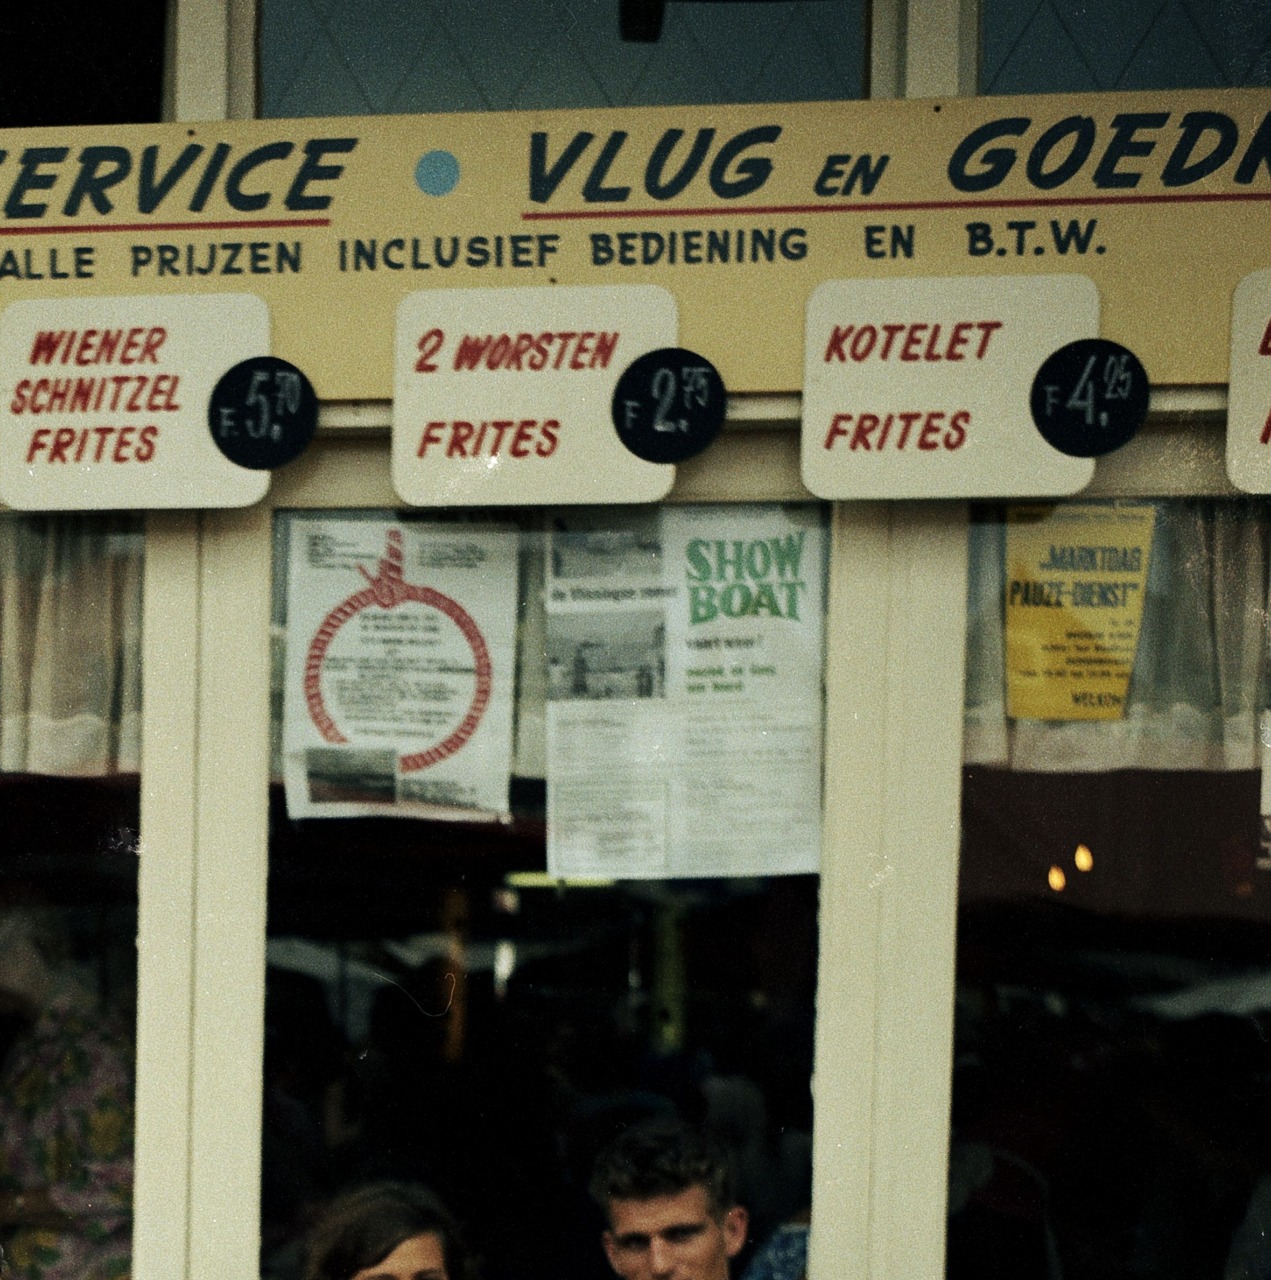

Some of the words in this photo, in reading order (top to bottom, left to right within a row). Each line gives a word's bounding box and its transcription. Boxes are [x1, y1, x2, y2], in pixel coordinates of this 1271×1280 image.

[529, 124, 783, 201] VLUG
[813, 153, 891, 197] EN
[130, 241, 303, 277] PRIJZEN
[339, 233, 560, 272] INCLUSIEF
[589, 227, 808, 266] BEDIENING
[864, 224, 915, 259] EN
[965, 218, 1107, 257] B.T.W.
[29, 326, 167, 367] WIENER
[415, 328, 445, 373] 2
[453, 331, 619, 371] WORSTEN
[824, 321, 1004, 363] KOTELET
[10, 374, 180, 415] SCHNITZEL
[26, 425, 159, 464] FRITES
[417, 419, 561, 459] FRITES
[824, 410, 971, 451] FRITES
[685, 530, 806, 583] SHOW
[687, 580, 807, 626] BOAT
